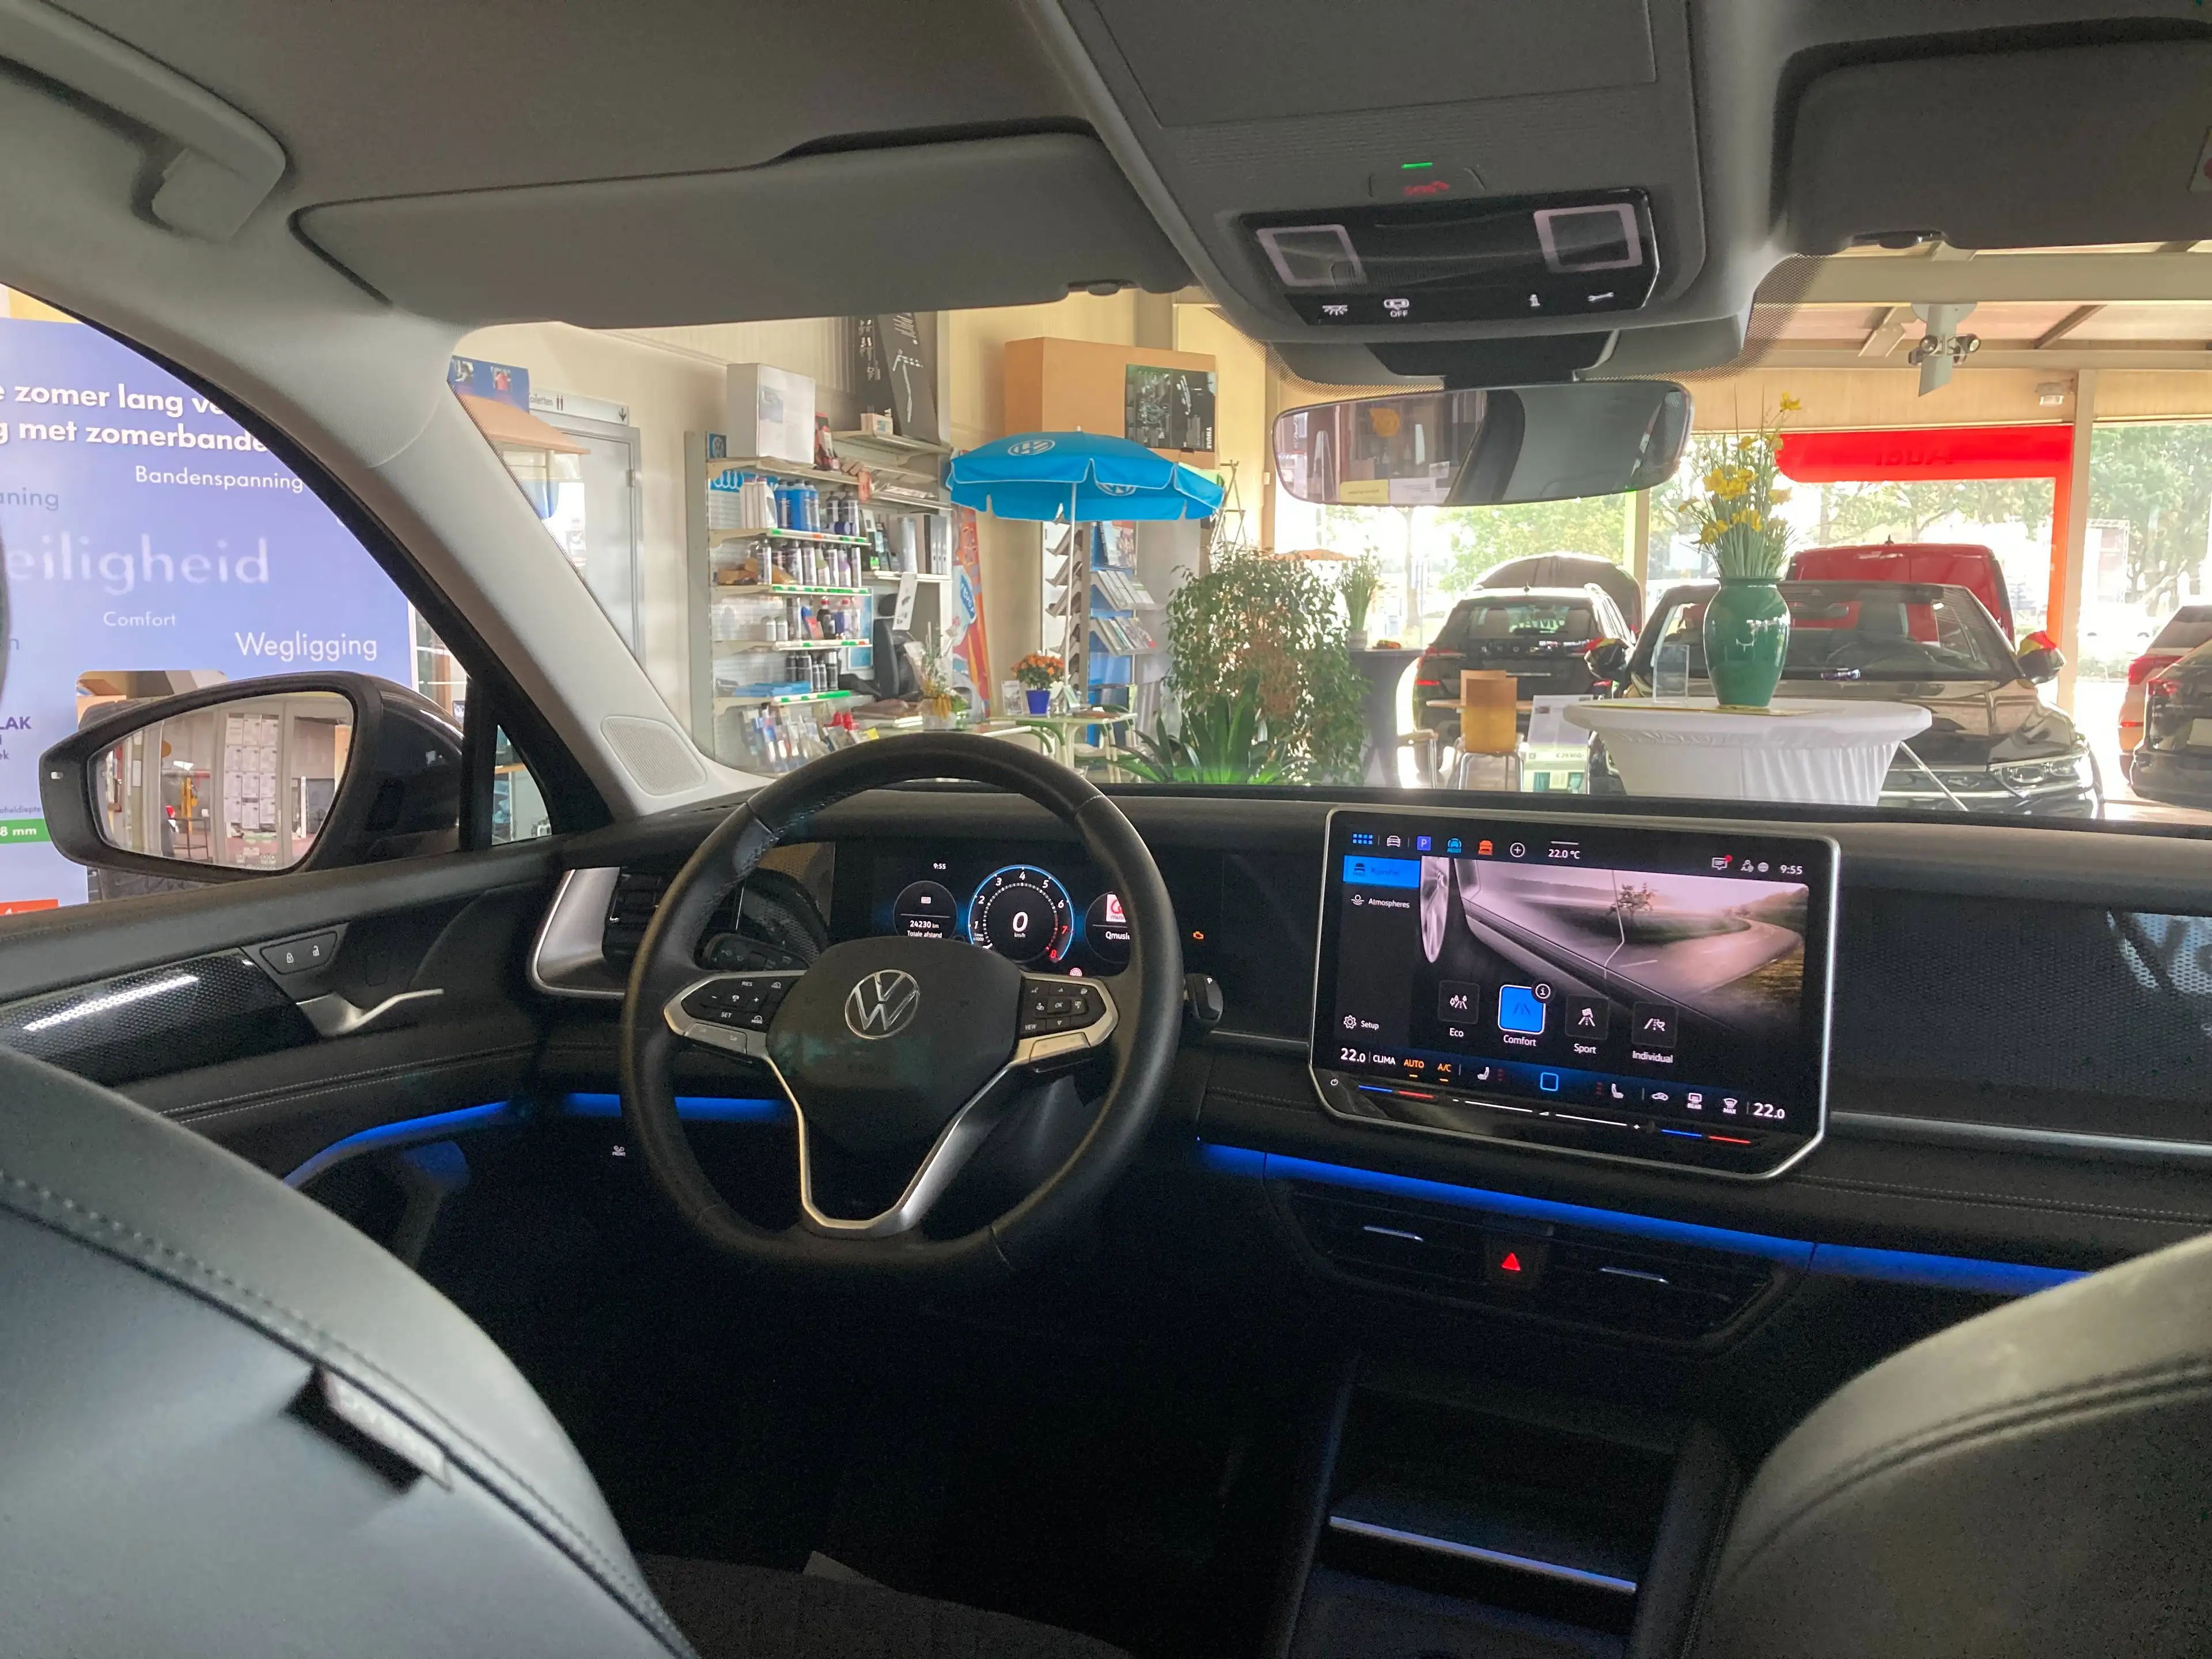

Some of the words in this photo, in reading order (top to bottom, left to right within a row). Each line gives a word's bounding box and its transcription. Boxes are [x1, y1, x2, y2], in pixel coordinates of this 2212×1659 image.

[14, 386, 109, 407] zomer
[118, 383, 183, 417] lang
[19, 421, 77, 441] met
[135, 465, 303, 494] Bandenspanning
[5, 532, 270, 596] eiligheid
[104, 611, 176, 626] Comfort
[235, 631, 377, 662] Wegligging
[13, 828, 37, 836] mm
[1548, 849, 1567, 858] 22.0
[1570, 850, 1581, 859] °C
[1780, 864, 1803, 875] 9:55
[1019, 871, 1026, 880] 4
[995, 877, 1002, 886] 3
[1042, 880, 1049, 888] 5
[978, 895, 985, 904] 2
[1058, 899, 1065, 908] 6
[1368, 897, 1410, 908] Atmospheres
[910, 920, 931, 929] 24230
[974, 921, 979, 930] 1
[1012, 911, 1028, 932] 0
[1062, 925, 1068, 934] 7
[1050, 949, 1057, 959] 8
[1361, 1020, 1379, 1030] Setup
[1449, 1028, 1464, 1037] Eco
[1503, 1035, 1536, 1047] Comfort
[1574, 1043, 1597, 1054] Sport
[1340, 1047, 1366, 1063] 22.0
[1373, 1055, 1396, 1065] CLIMA
[1633, 1050, 1673, 1063] Individual
[1404, 1059, 1425, 1069] AUTO
[1437, 1063, 1452, 1073] A/C
[1753, 1102, 1785, 1119] 22.0
